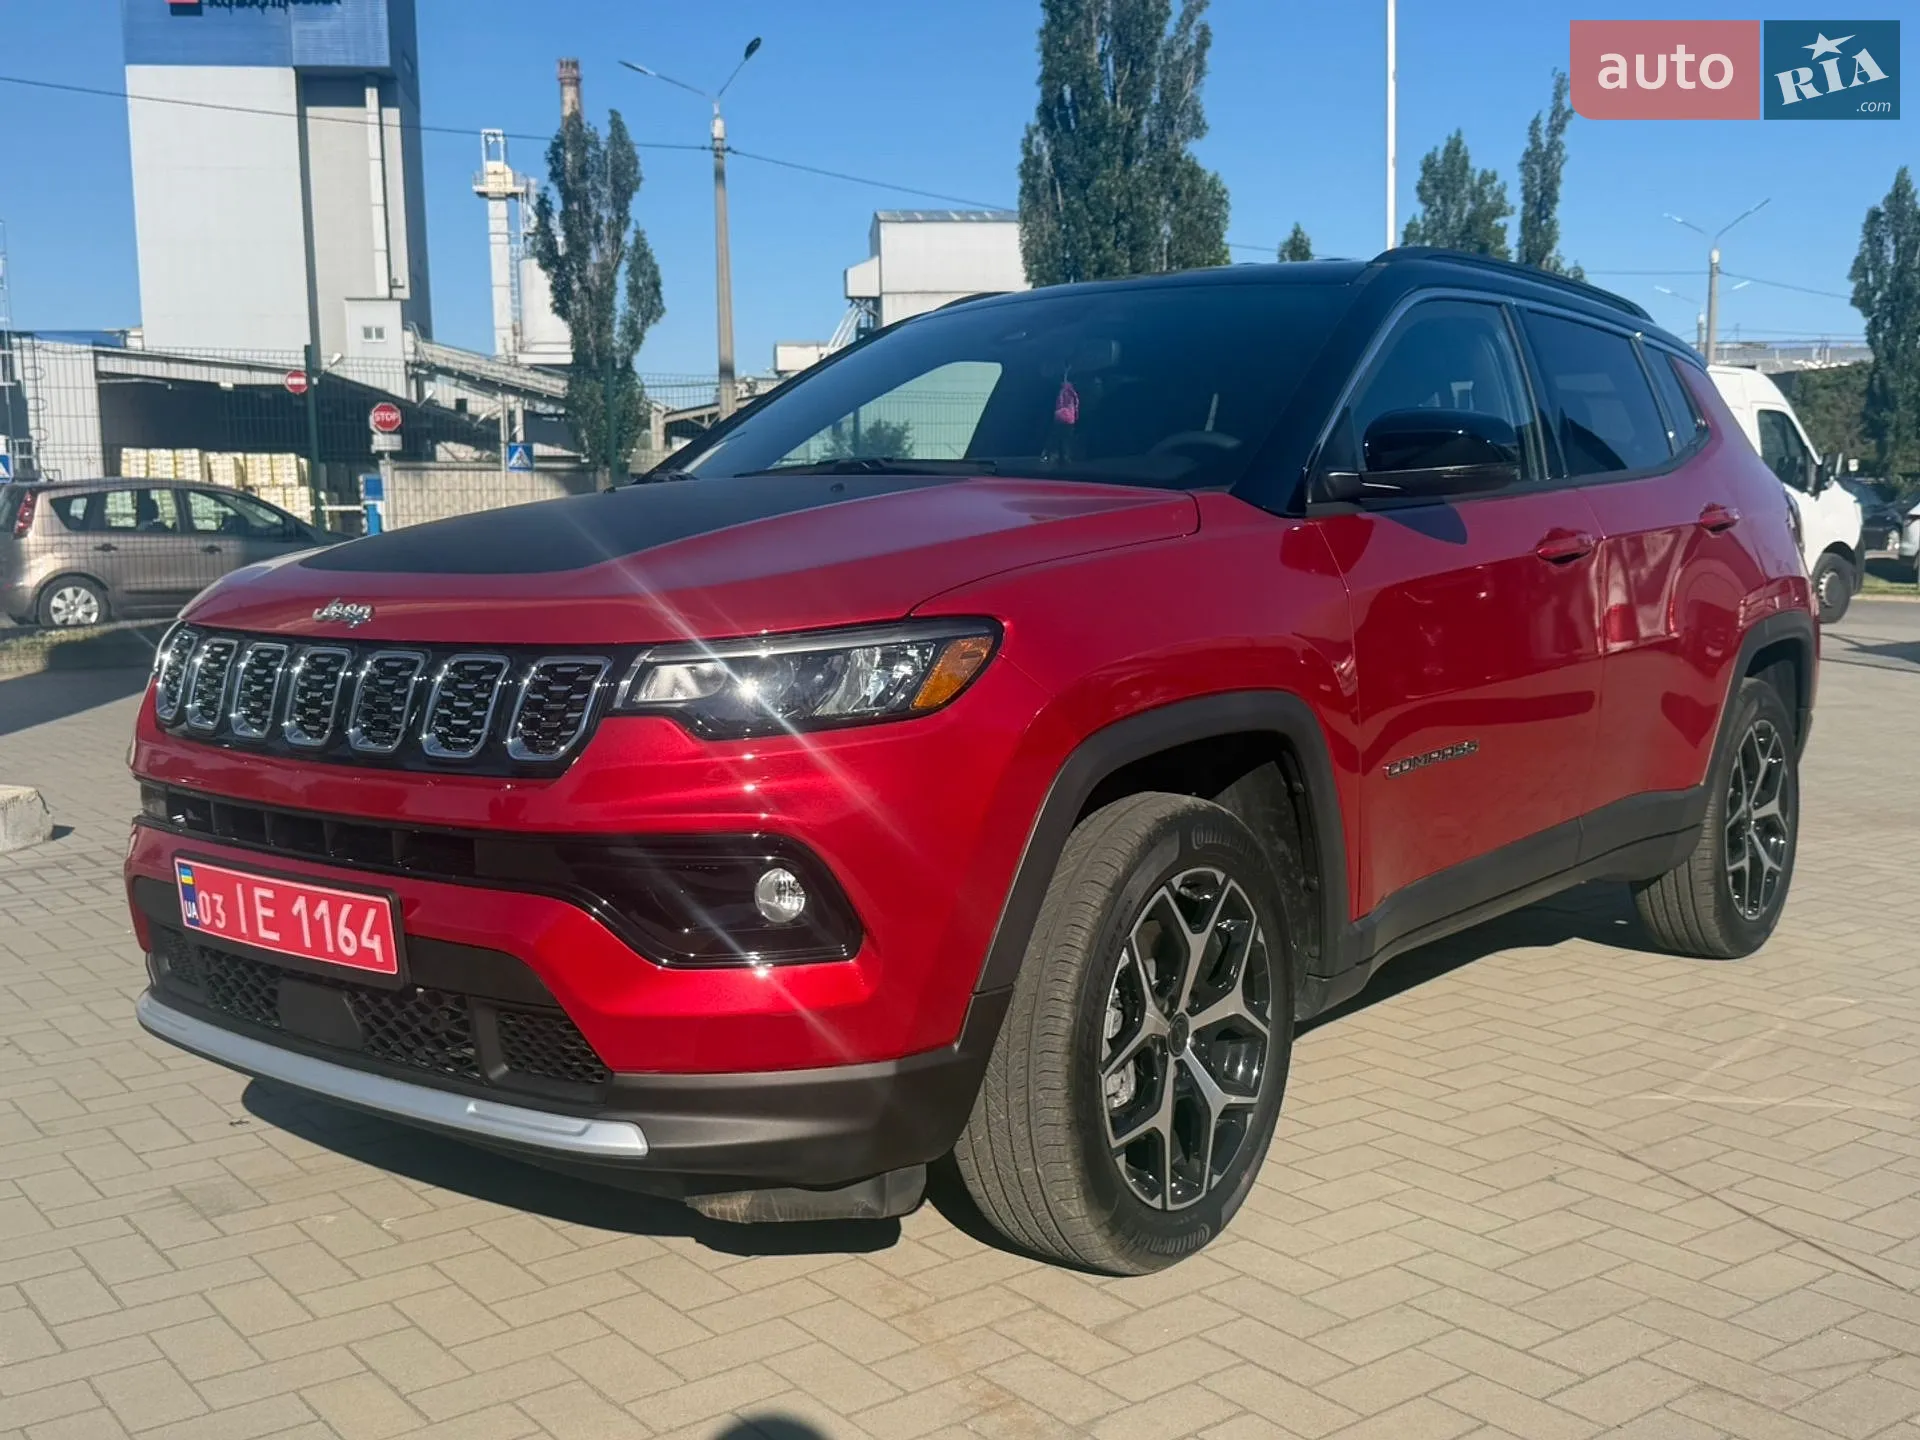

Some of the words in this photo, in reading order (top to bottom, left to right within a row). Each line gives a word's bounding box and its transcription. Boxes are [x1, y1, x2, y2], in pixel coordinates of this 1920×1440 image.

[374, 410, 399, 422] STOP
[312, 597, 373, 629] Jeep
[1383, 740, 1479, 779] COMPASS
[184, 900, 199, 920] UA
[198, 890, 227, 929] 03
[236, 883, 280, 942] IE
[292, 895, 384, 963] 1164
